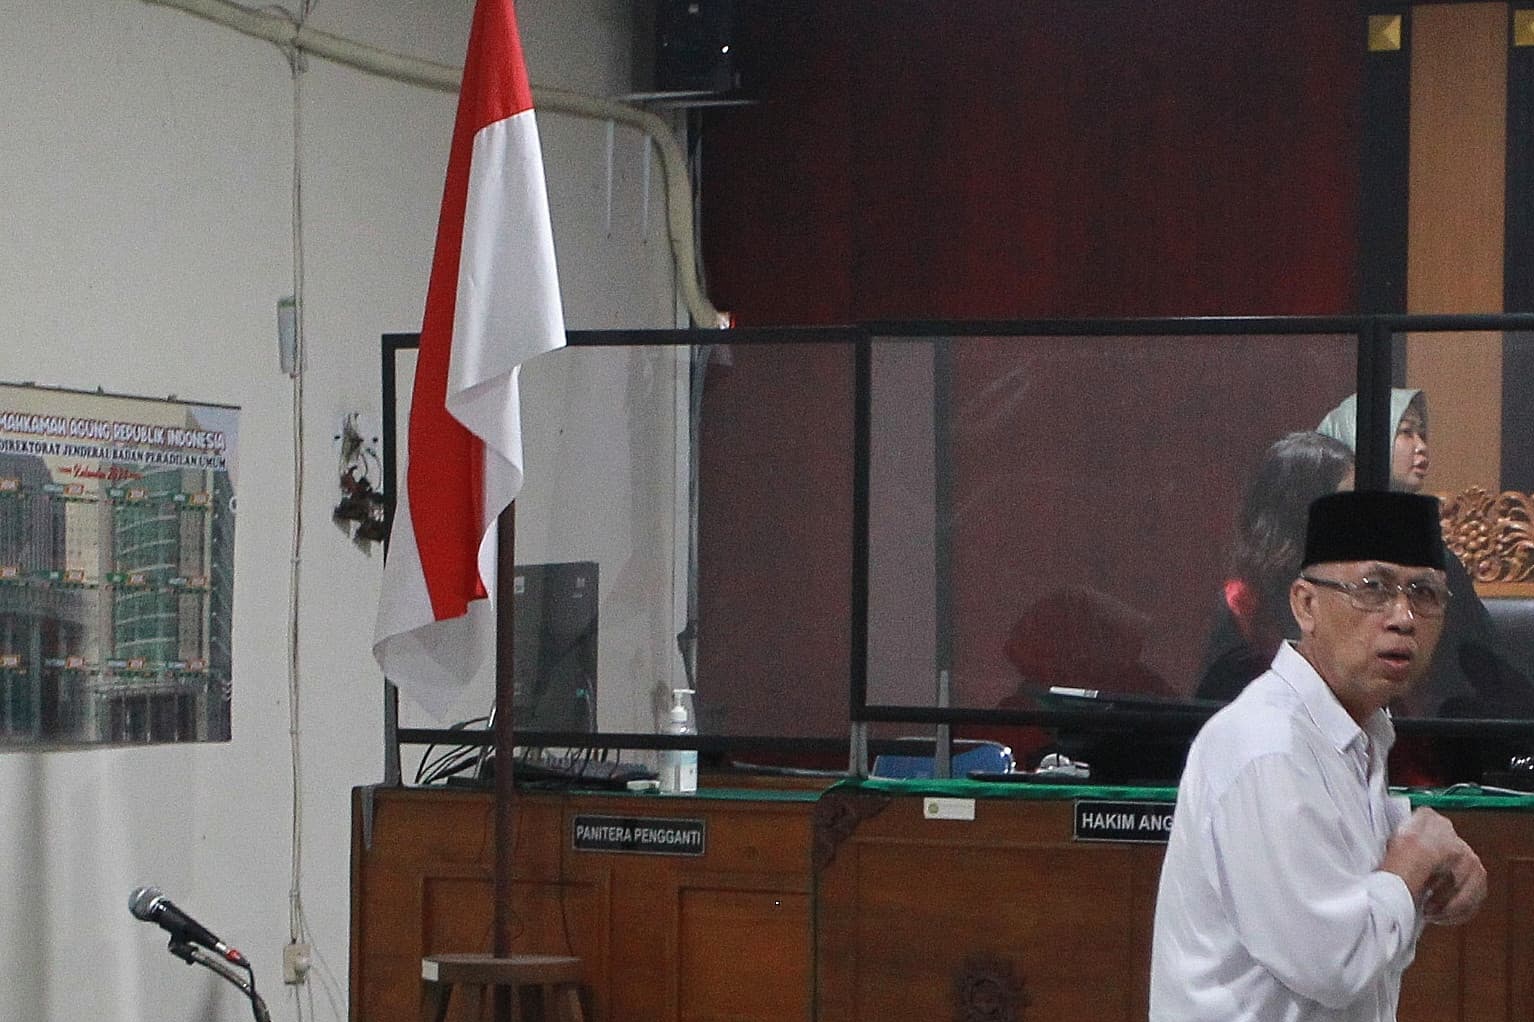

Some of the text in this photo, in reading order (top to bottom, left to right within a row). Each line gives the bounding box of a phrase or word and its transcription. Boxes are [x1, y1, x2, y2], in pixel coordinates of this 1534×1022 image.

[69, 417, 111, 441] AGUNG
[112, 421, 165, 446] REPUBLIK
[166, 426, 226, 451] INDONESIA
[112, 447, 144, 462] BADAN
[145, 451, 198, 466] PERADILAN
[199, 455, 226, 469] UMUM
[1082, 812, 1135, 831] HAKIM
[576, 825, 700, 845] PANITERA PENGGANTI
